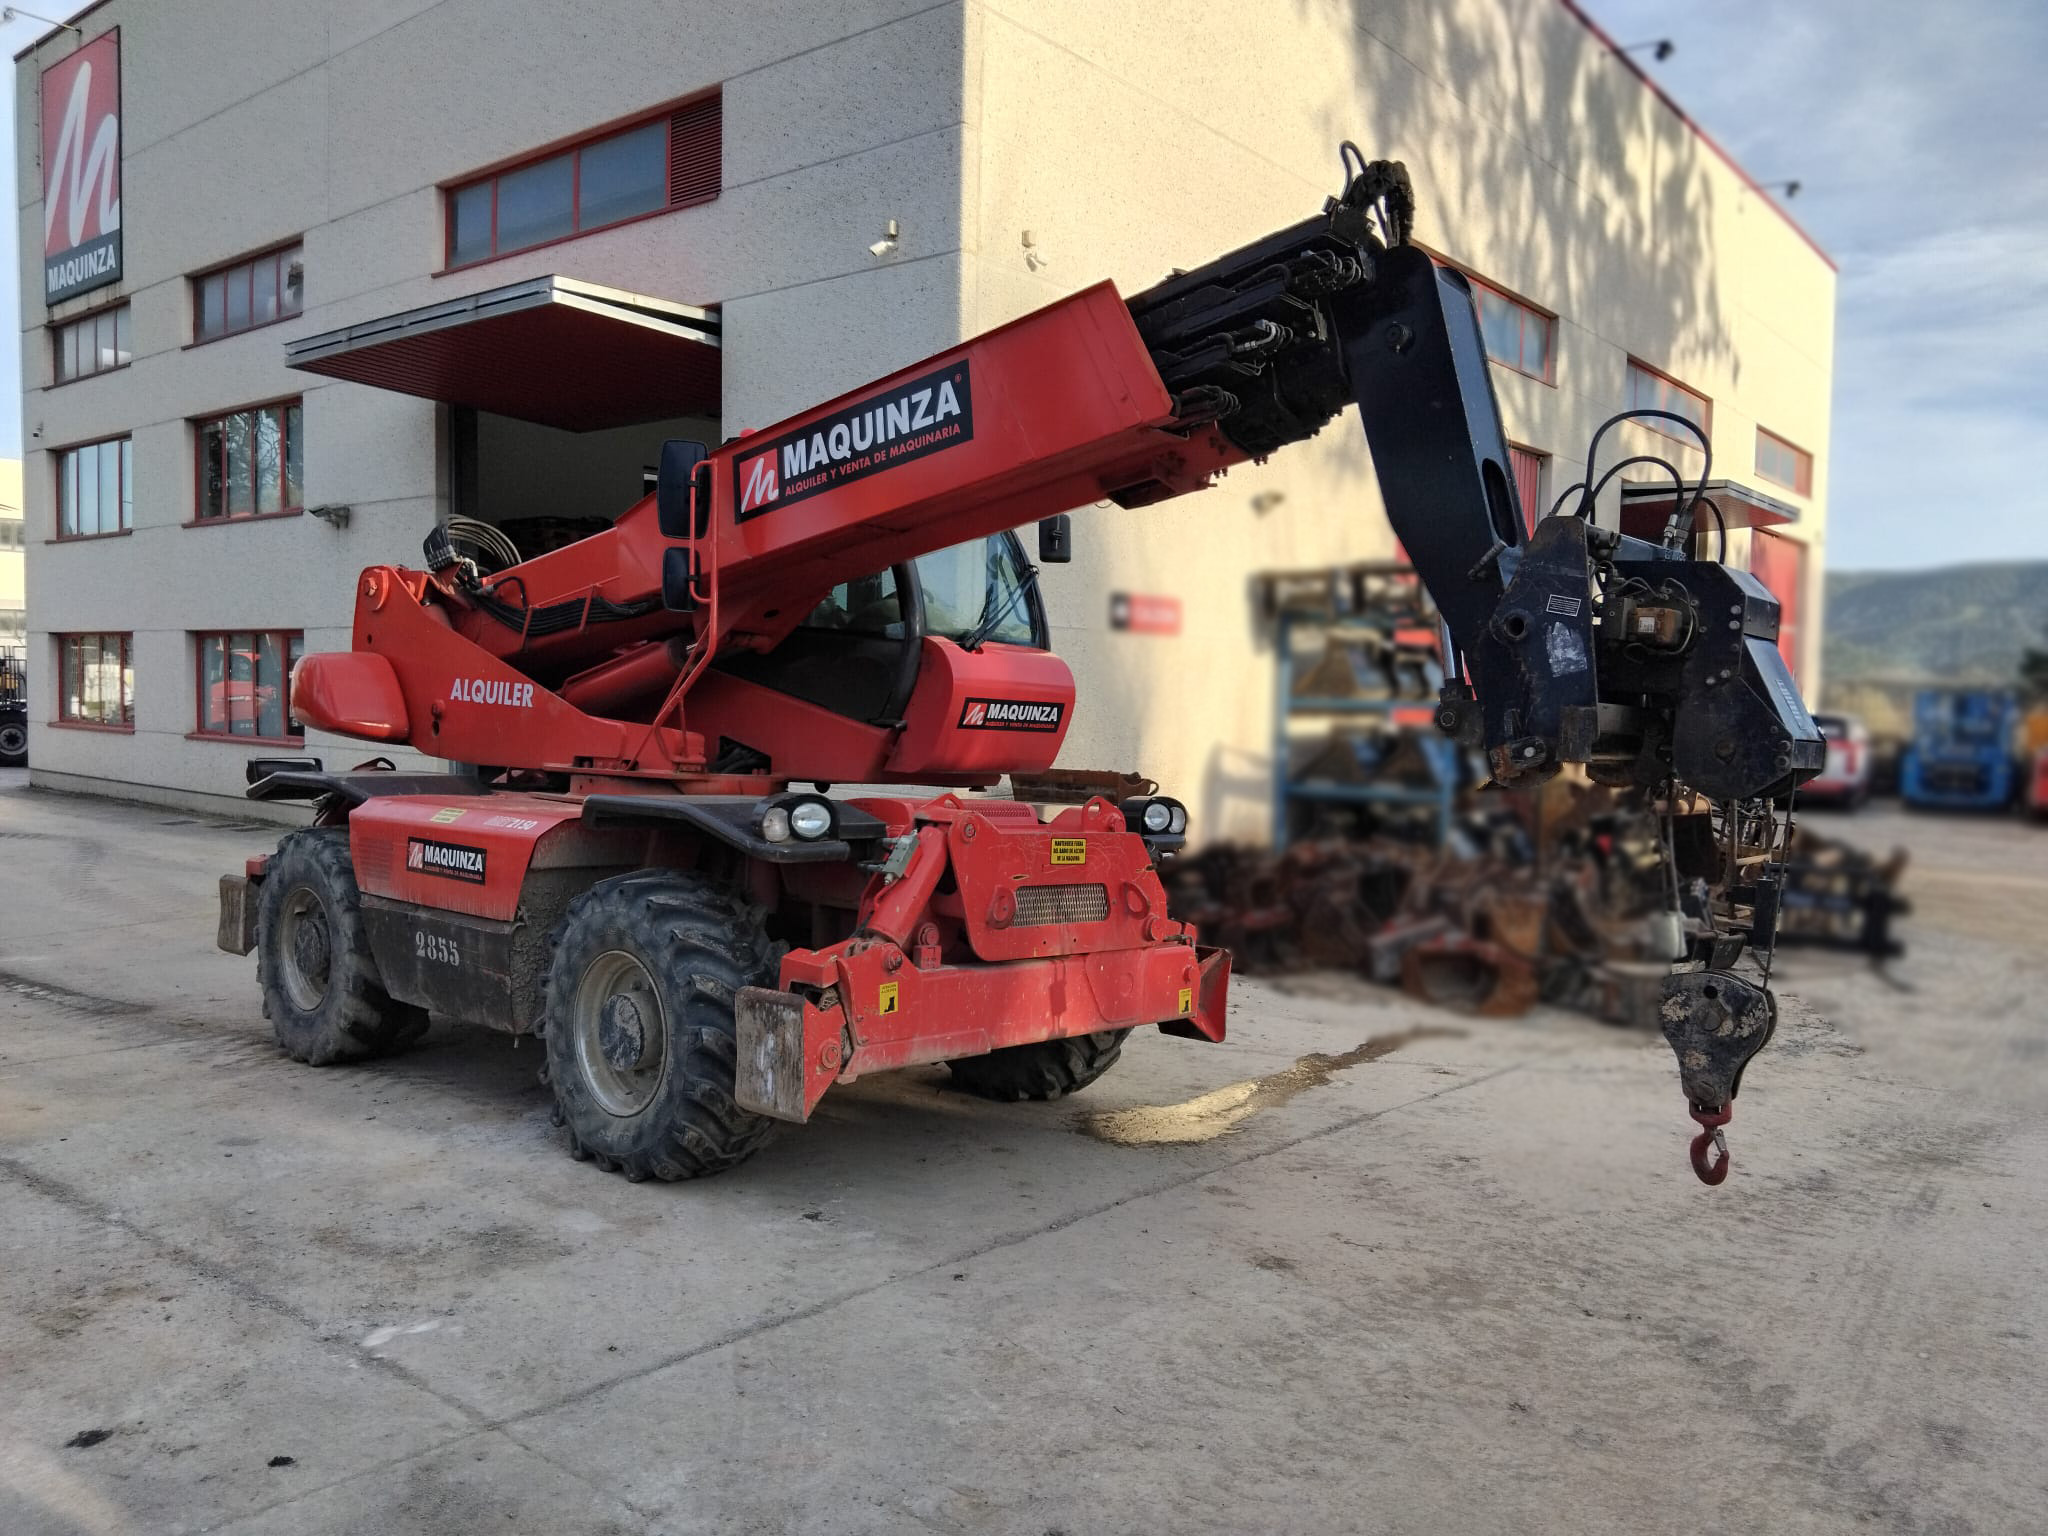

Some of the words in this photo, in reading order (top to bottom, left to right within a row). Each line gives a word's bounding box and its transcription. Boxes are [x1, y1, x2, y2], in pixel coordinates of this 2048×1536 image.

[48, 244, 116, 293] MAQUINZA
[783, 380, 961, 480] MAQUINZA
[785, 472, 828, 497] ALQUILER
[830, 468, 837, 480] Y
[839, 458, 871, 476] VENTA
[874, 449, 887, 464] DE
[889, 423, 961, 458] MAQUINARIA
[450, 678, 534, 708] ALQUILER
[987, 703, 1058, 722] MAQUINZA
[424, 845, 483, 872] MAQUINZA
[415, 931, 460, 967] 2855
